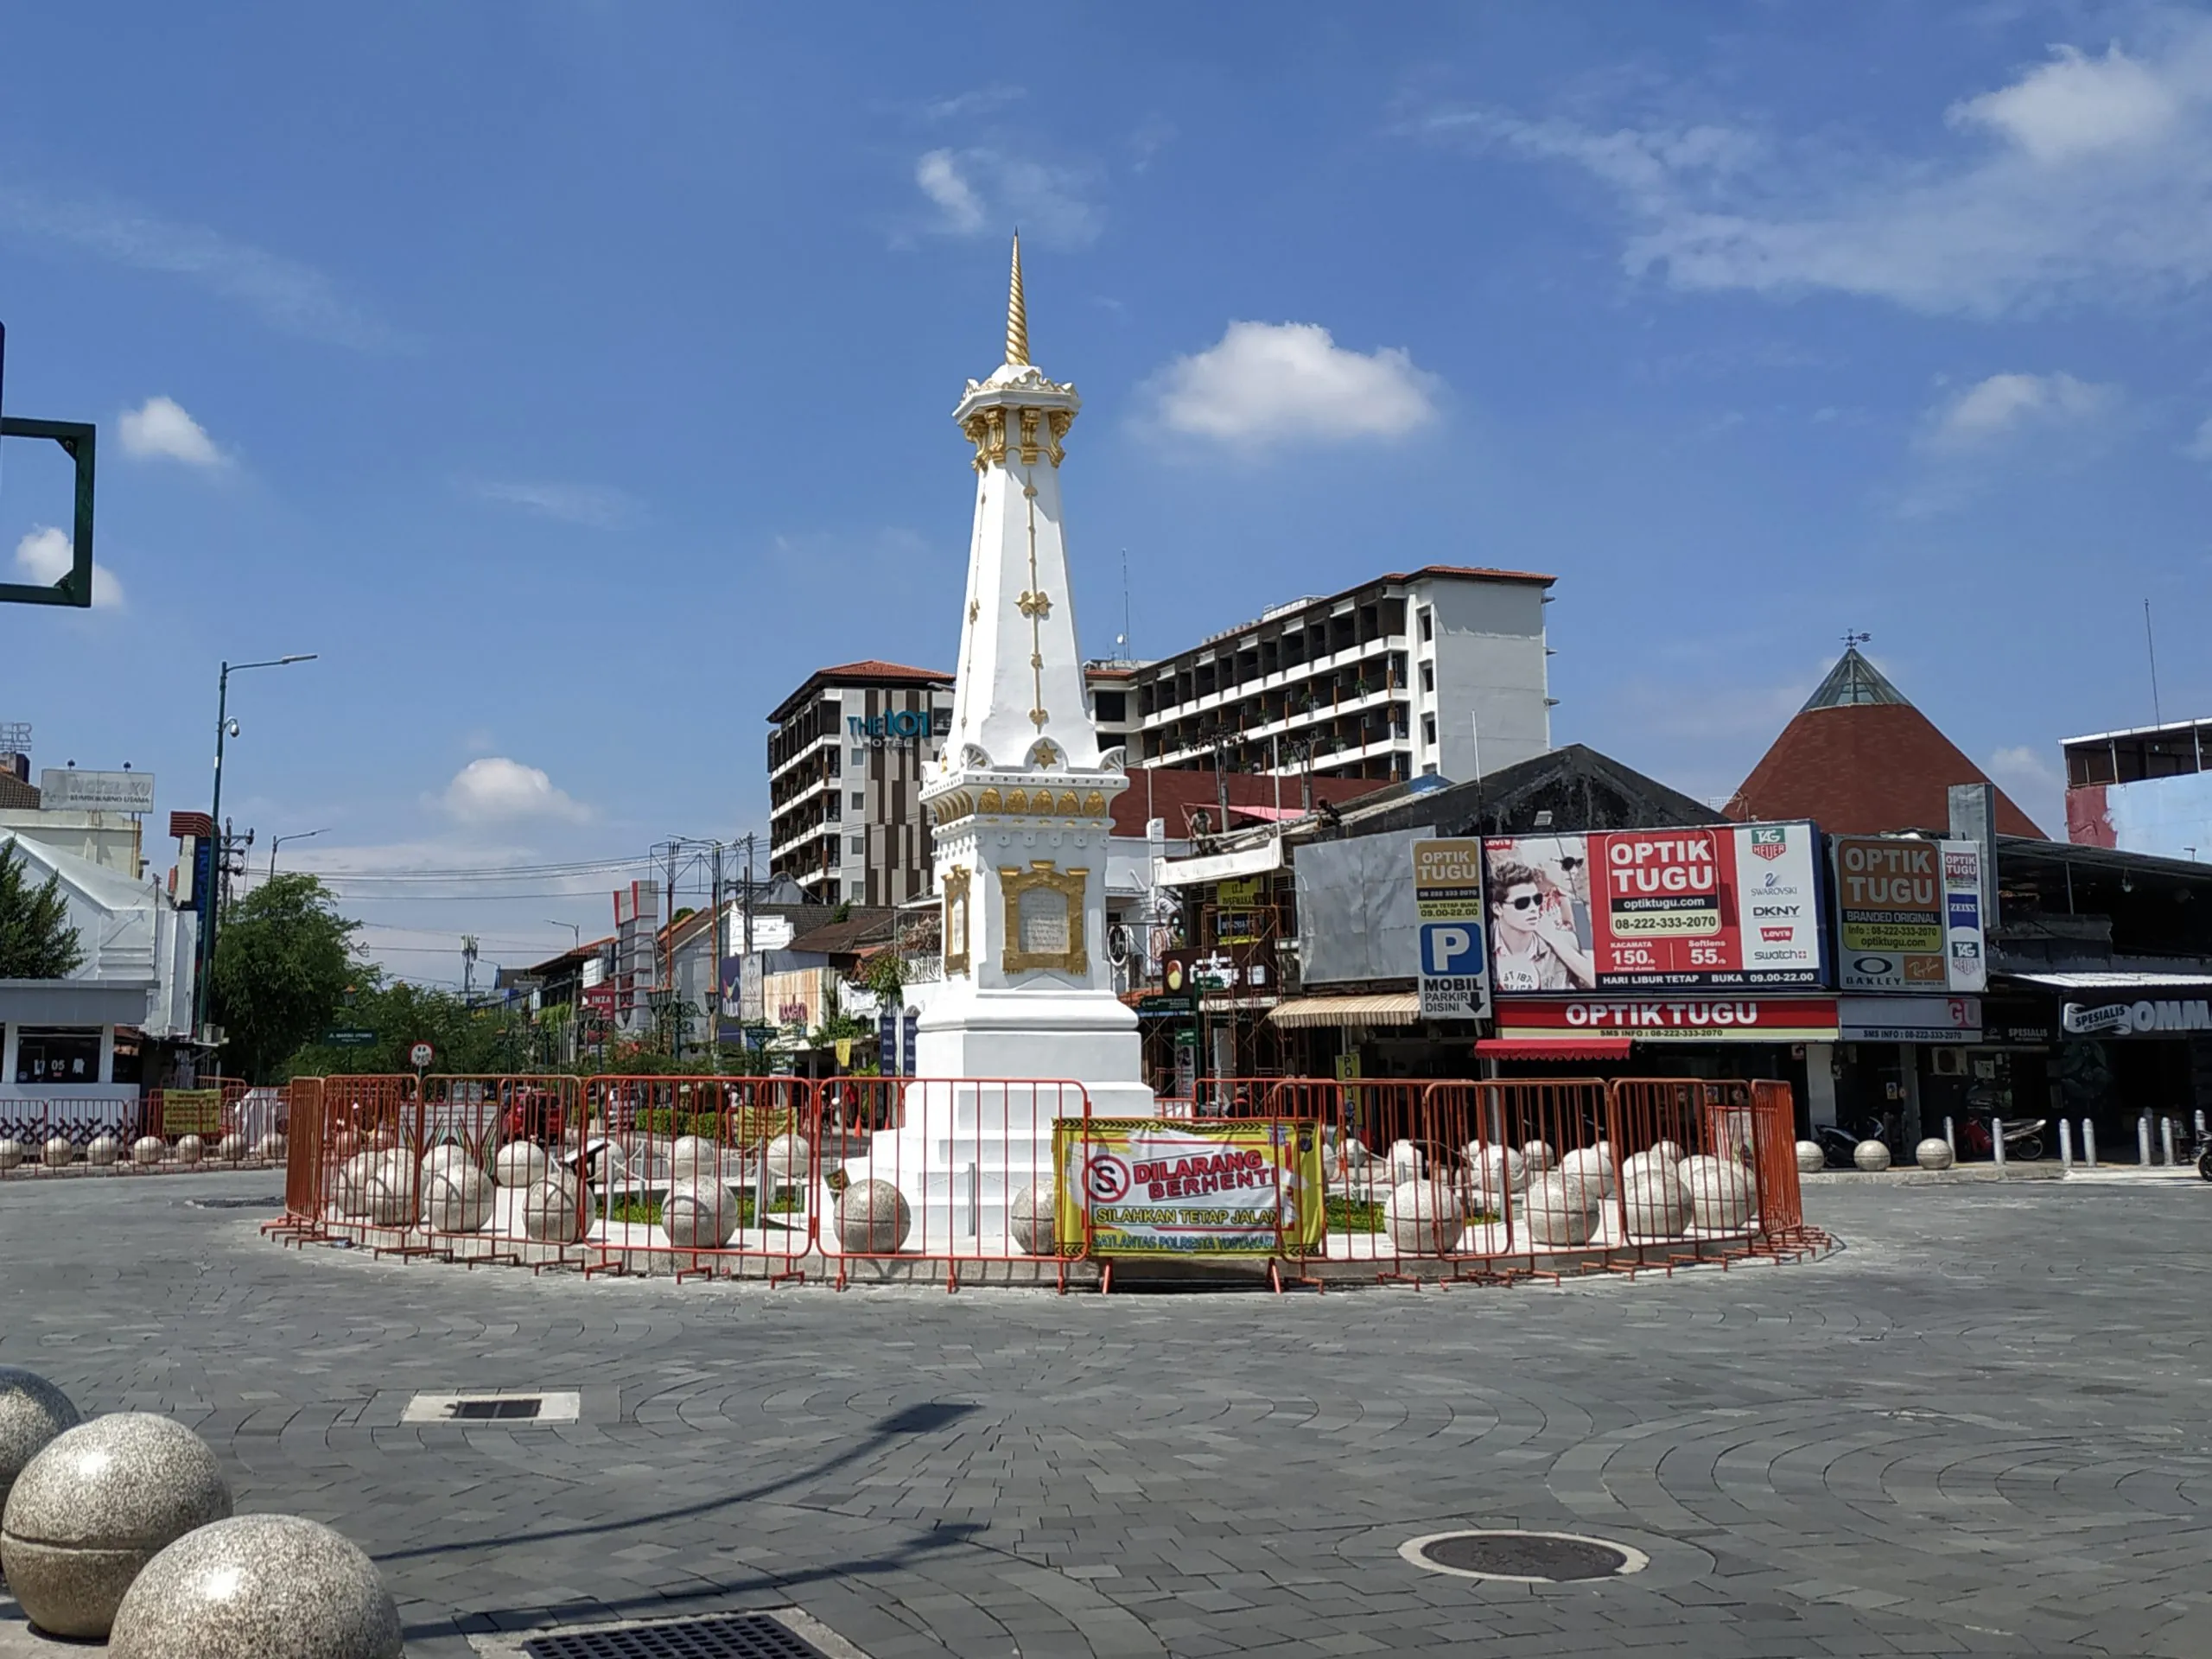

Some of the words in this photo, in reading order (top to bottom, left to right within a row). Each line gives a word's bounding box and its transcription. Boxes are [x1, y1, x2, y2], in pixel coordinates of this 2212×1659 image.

[847, 716, 884, 735] THE
[885, 709, 931, 737] 101
[862, 739, 912, 747] HOTEL
[1756, 830, 1781, 842] TAG
[1421, 851, 1470, 864] OPTIK
[1611, 840, 1712, 865] OPTIK
[1753, 844, 1785, 860] HEUER
[1846, 848, 1932, 874] OPTIK
[1946, 855, 1975, 865] OPTIK
[1417, 864, 1476, 880] TUGU
[1946, 865, 1977, 875] TUGU
[1612, 866, 1713, 893] TUGU
[1751, 887, 1797, 896] SWAROVSKI
[1847, 876, 1933, 904] TUGU
[1624, 897, 1705, 910] optiktugu.com
[1950, 903, 1976, 912] ZEISS
[1421, 908, 1478, 917] 09.00-22.00
[1753, 905, 1800, 916] DKNY
[1615, 916, 1716, 930] 08-222-333-2070
[1847, 911, 1892, 923] BRANDED
[1894, 912, 1936, 924] ORIGINAL
[1848, 926, 1865, 935] Info
[1872, 926, 1937, 936] 08-222-333-2070
[1431, 927, 1470, 972] P
[1861, 937, 1926, 949] optiktugu.com
[1754, 950, 1797, 960] swatch
[1955, 943, 1976, 957] TAG
[1424, 977, 1484, 991] MOBIL
[1631, 975, 1662, 983] LIBUR
[1665, 975, 1699, 983] TETAP
[1712, 974, 1743, 982] BUKA
[1750, 973, 1815, 982] 09.00-22.00
[1846, 976, 1901, 985] OAKLEY
[1425, 992, 1469, 1002] PARKIR
[1425, 1002, 1459, 1012] DISINI
[1566, 1004, 1664, 1026] OPTIK
[1667, 1002, 1758, 1024] TUGU
[2075, 1005, 2126, 1028] SPESIALIS
[2132, 1000, 2212, 1032] OMM
[1133, 1149, 1263, 1185] DILARANG
[1148, 1166, 1275, 1200] BERHENTI
[1096, 1208, 1176, 1224] SILAHKAN
[1179, 1209, 1228, 1224] TETAP
